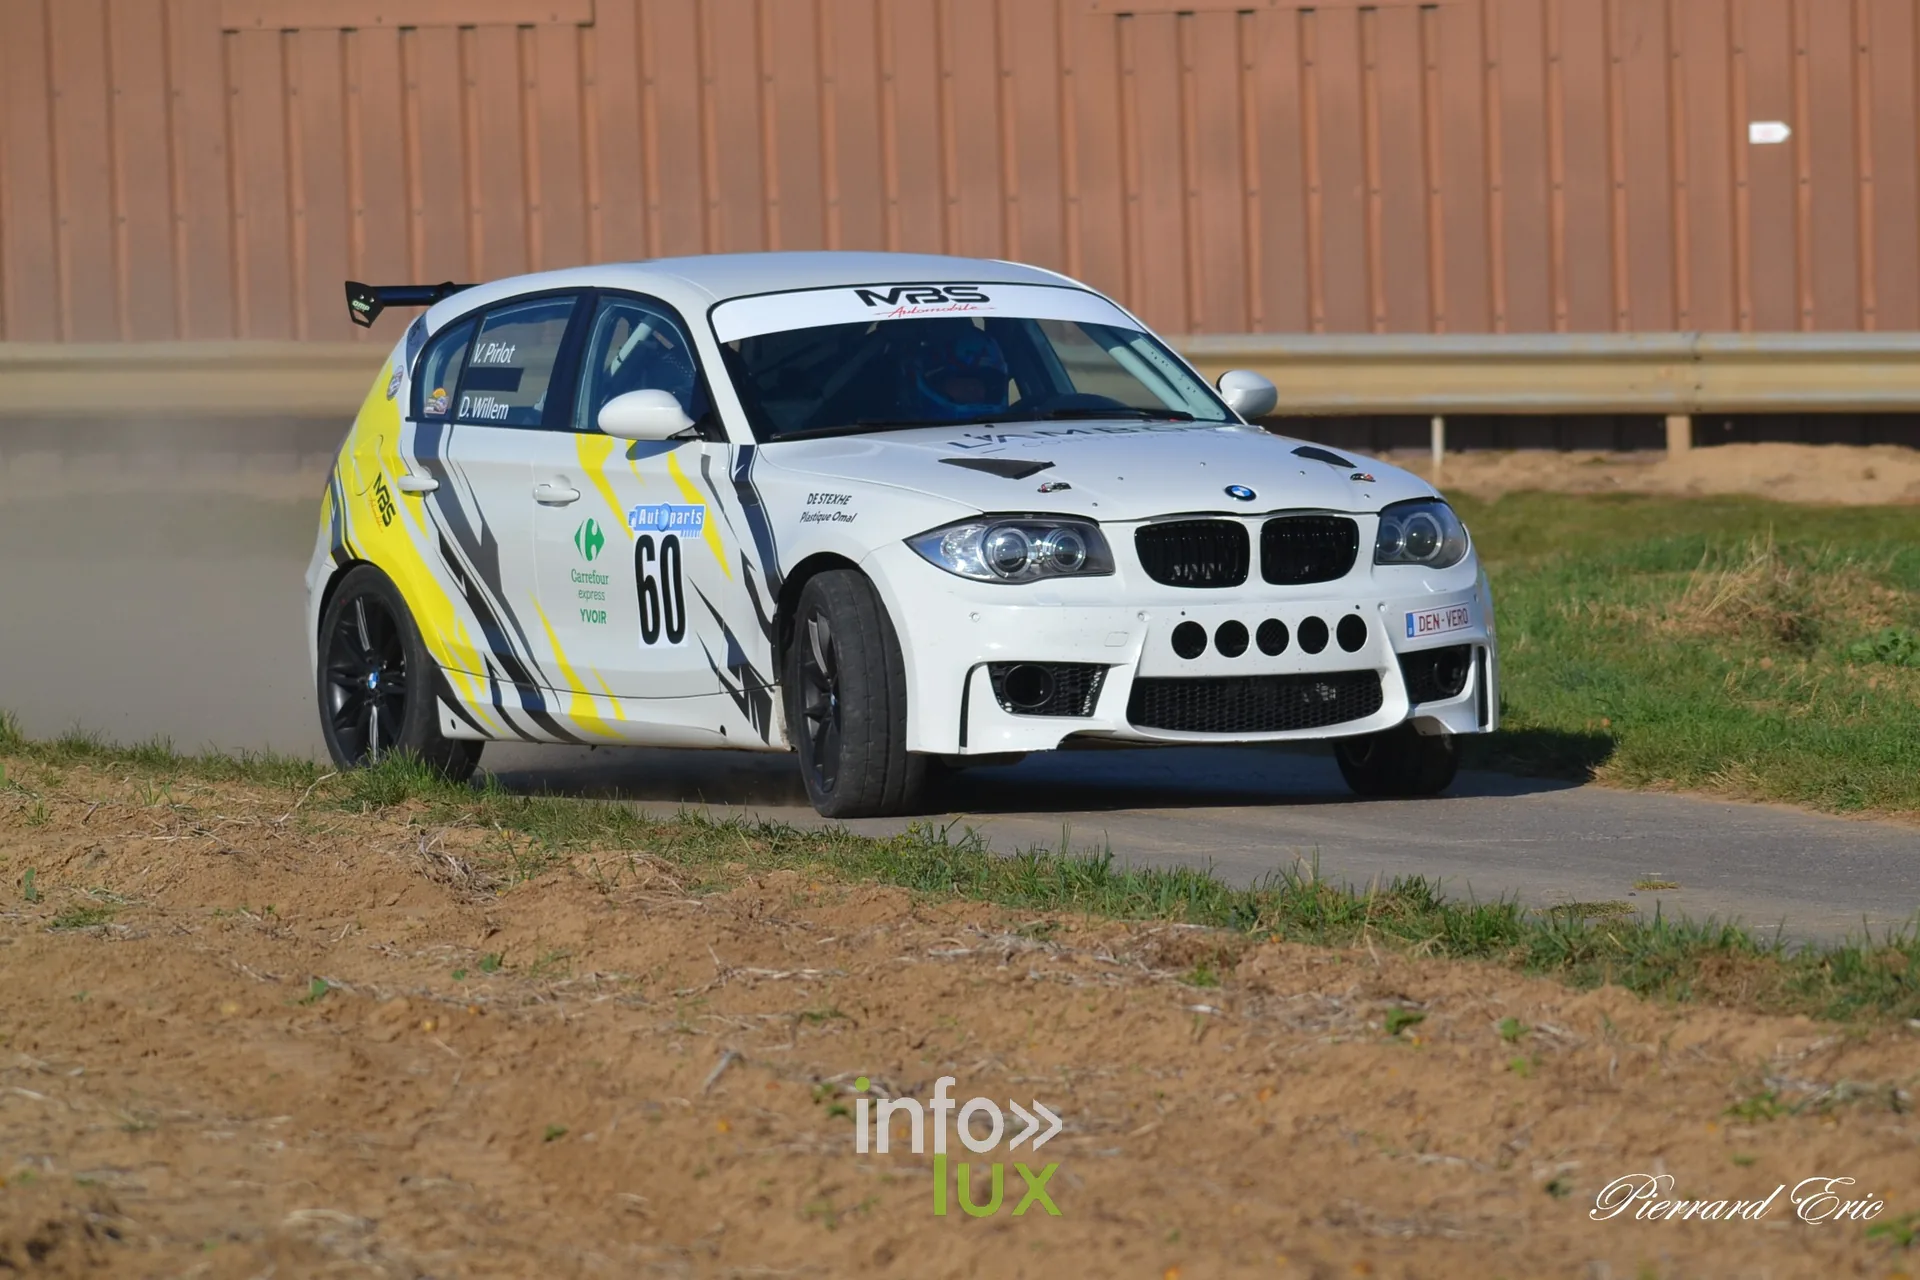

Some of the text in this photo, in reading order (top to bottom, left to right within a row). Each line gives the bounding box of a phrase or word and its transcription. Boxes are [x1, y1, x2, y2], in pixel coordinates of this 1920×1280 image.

[854, 286, 991, 307] MBS
[473, 342, 516, 364] V. Pirlot
[458, 396, 471, 418] D.
[472, 396, 509, 420] Willem
[373, 471, 396, 527] MBS
[817, 492, 853, 505] STEXHE
[799, 510, 858, 525] Plastique Omal
[570, 568, 609, 585] Carrefour
[578, 589, 606, 603] express
[634, 533, 686, 645] 60
[580, 608, 607, 624] YVOIR
